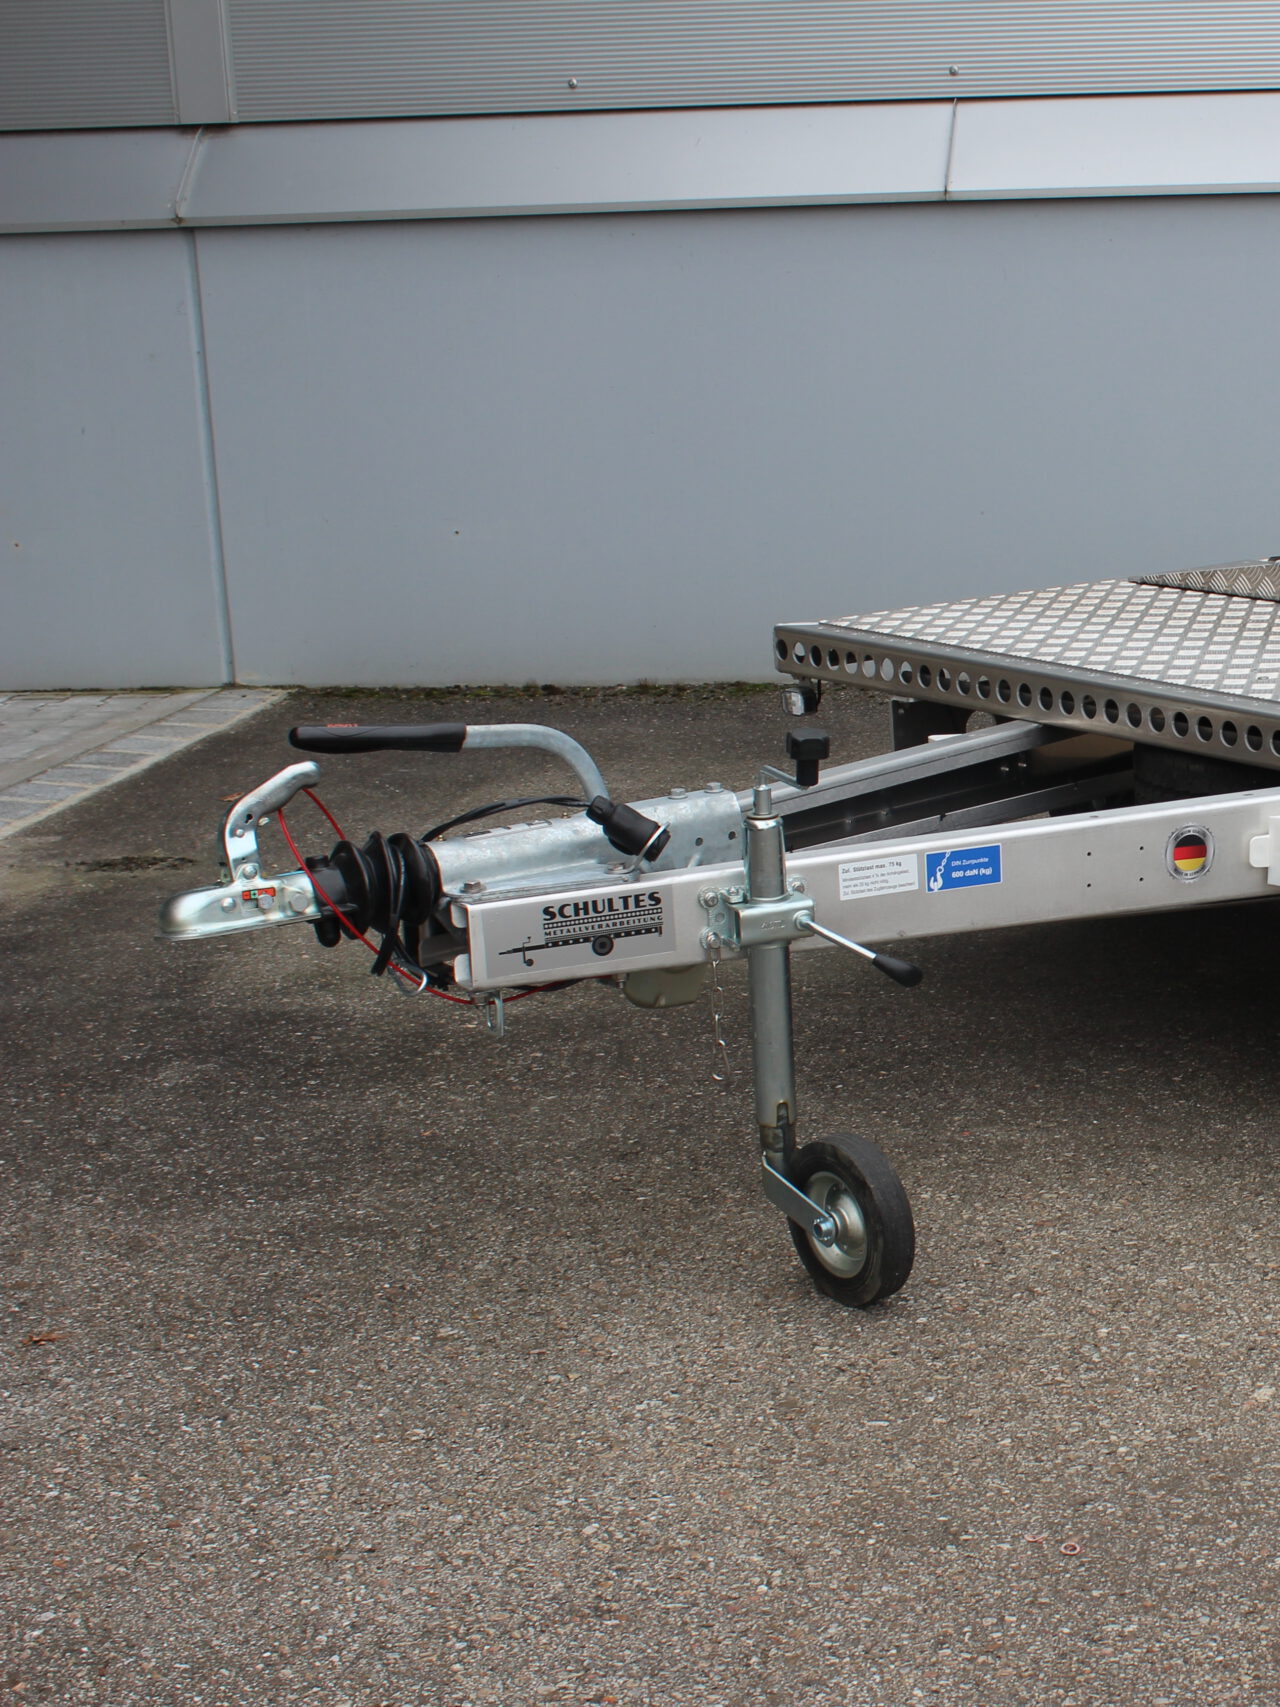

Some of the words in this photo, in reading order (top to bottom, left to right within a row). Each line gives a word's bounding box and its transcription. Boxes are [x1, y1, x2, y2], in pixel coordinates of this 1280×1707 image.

[962, 857, 989, 866] Zurrpunkte
[964, 868, 979, 877] daN
[979, 867, 993, 876] (kg)
[542, 891, 662, 921] SCHULTES
[544, 915, 663, 937] METALLVERARBEITUNG
